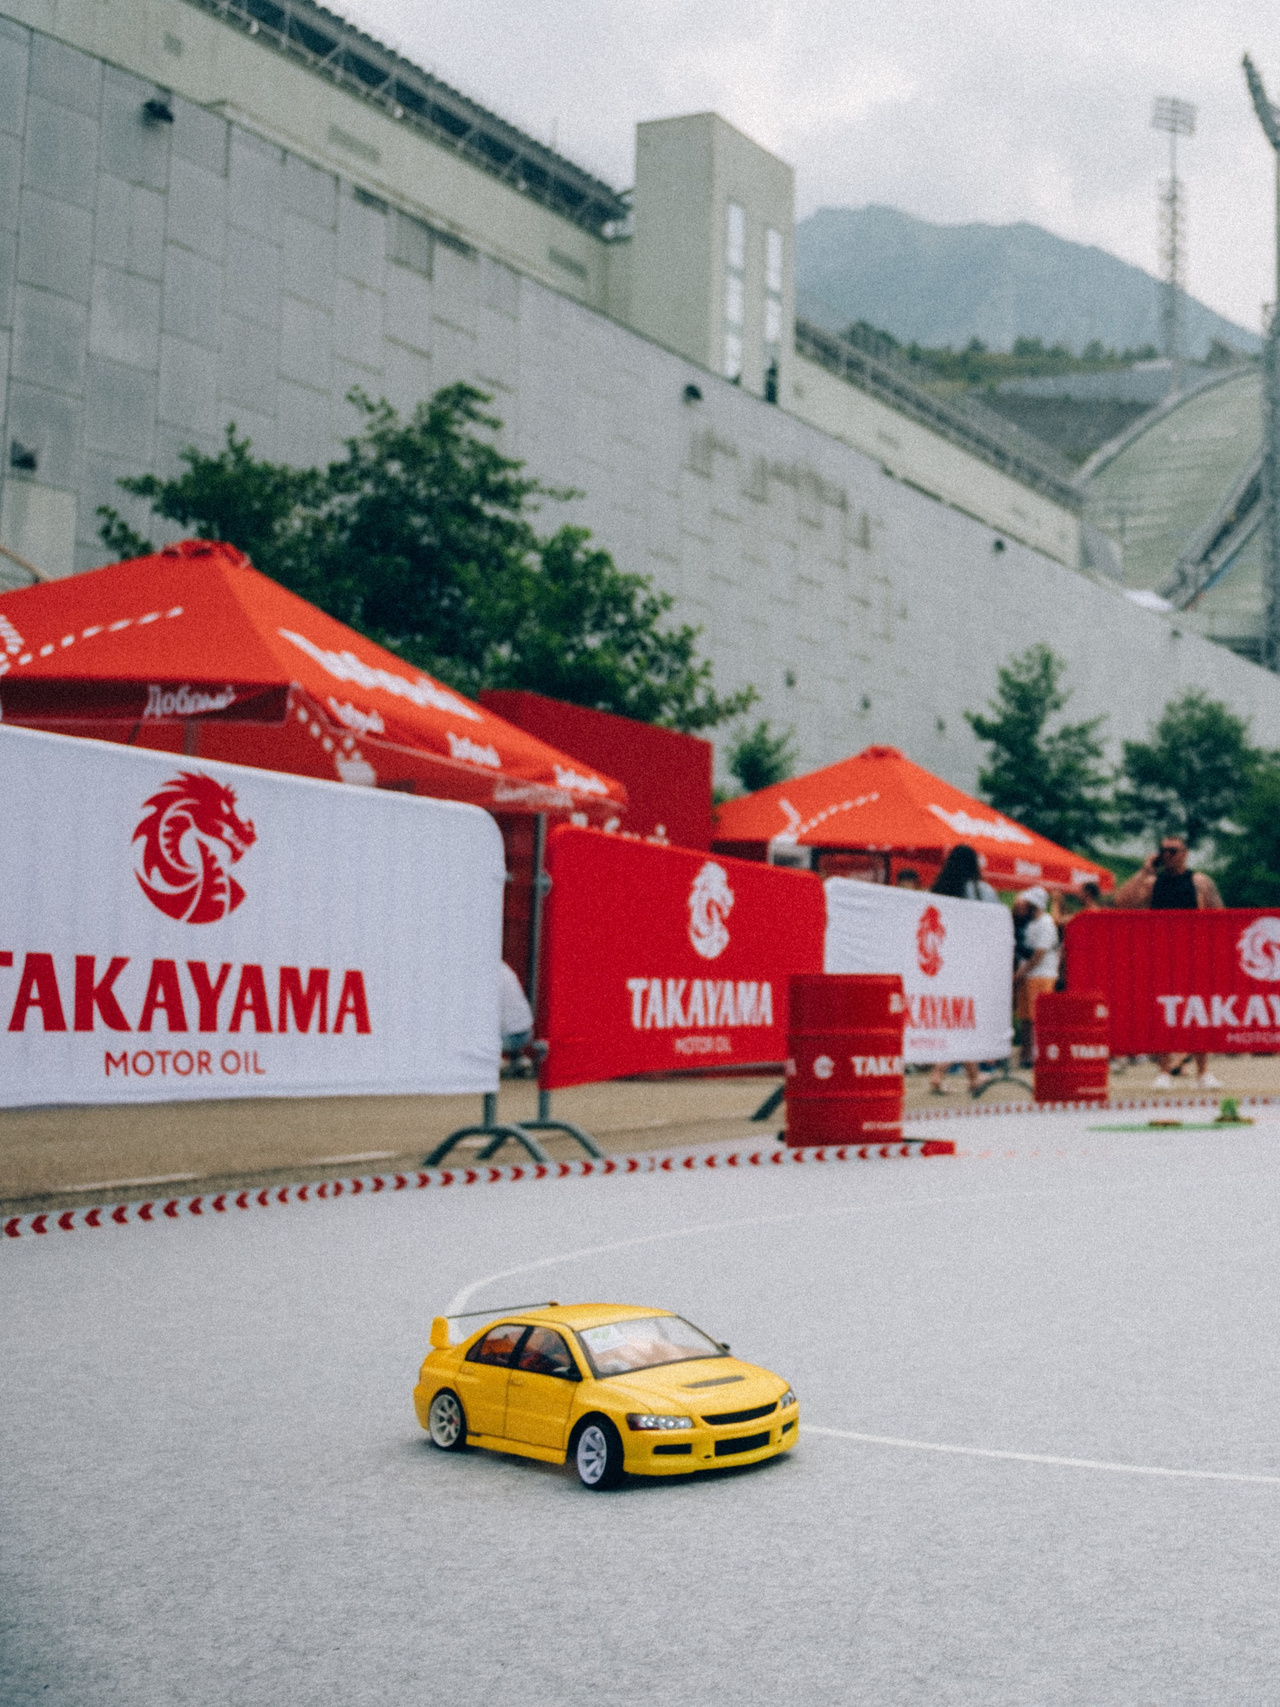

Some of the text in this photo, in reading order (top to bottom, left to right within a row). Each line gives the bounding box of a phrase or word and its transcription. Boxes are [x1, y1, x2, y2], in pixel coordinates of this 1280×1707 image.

[0, 951, 372, 1034] AKAYAMA
[627, 978, 773, 1029] TAKAYAMA
[104, 1050, 266, 1077] MOTOR OIL
